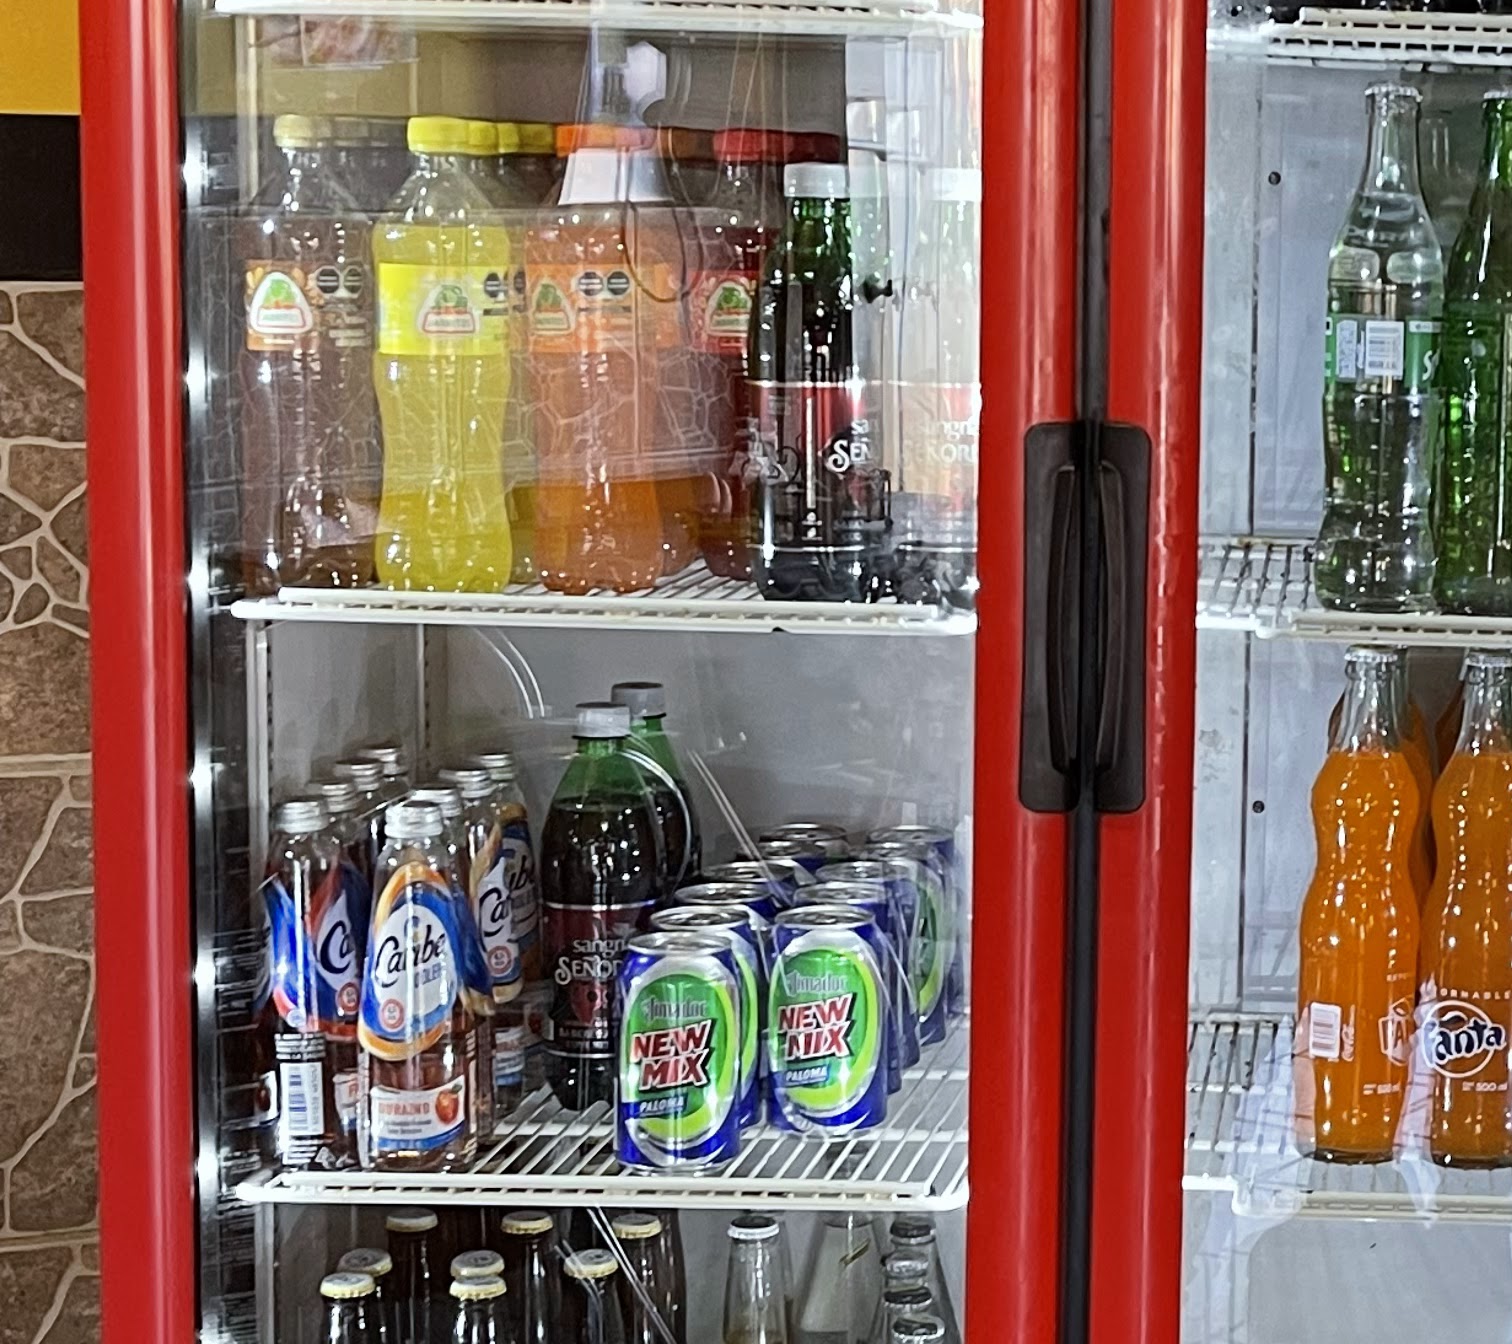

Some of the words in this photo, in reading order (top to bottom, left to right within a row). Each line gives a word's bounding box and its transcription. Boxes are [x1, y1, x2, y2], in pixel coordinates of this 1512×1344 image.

[778, 992, 853, 1034] NEW
[1438, 988, 1512, 1001] ORNABLE
[629, 1020, 713, 1062] NEW
[785, 1020, 851, 1061] MIX
[1422, 1015, 1508, 1068] Fanta
[639, 1048, 710, 1092] MIX
[785, 1065, 829, 1083] PALOMA
[638, 1096, 685, 1114] PALOMA
